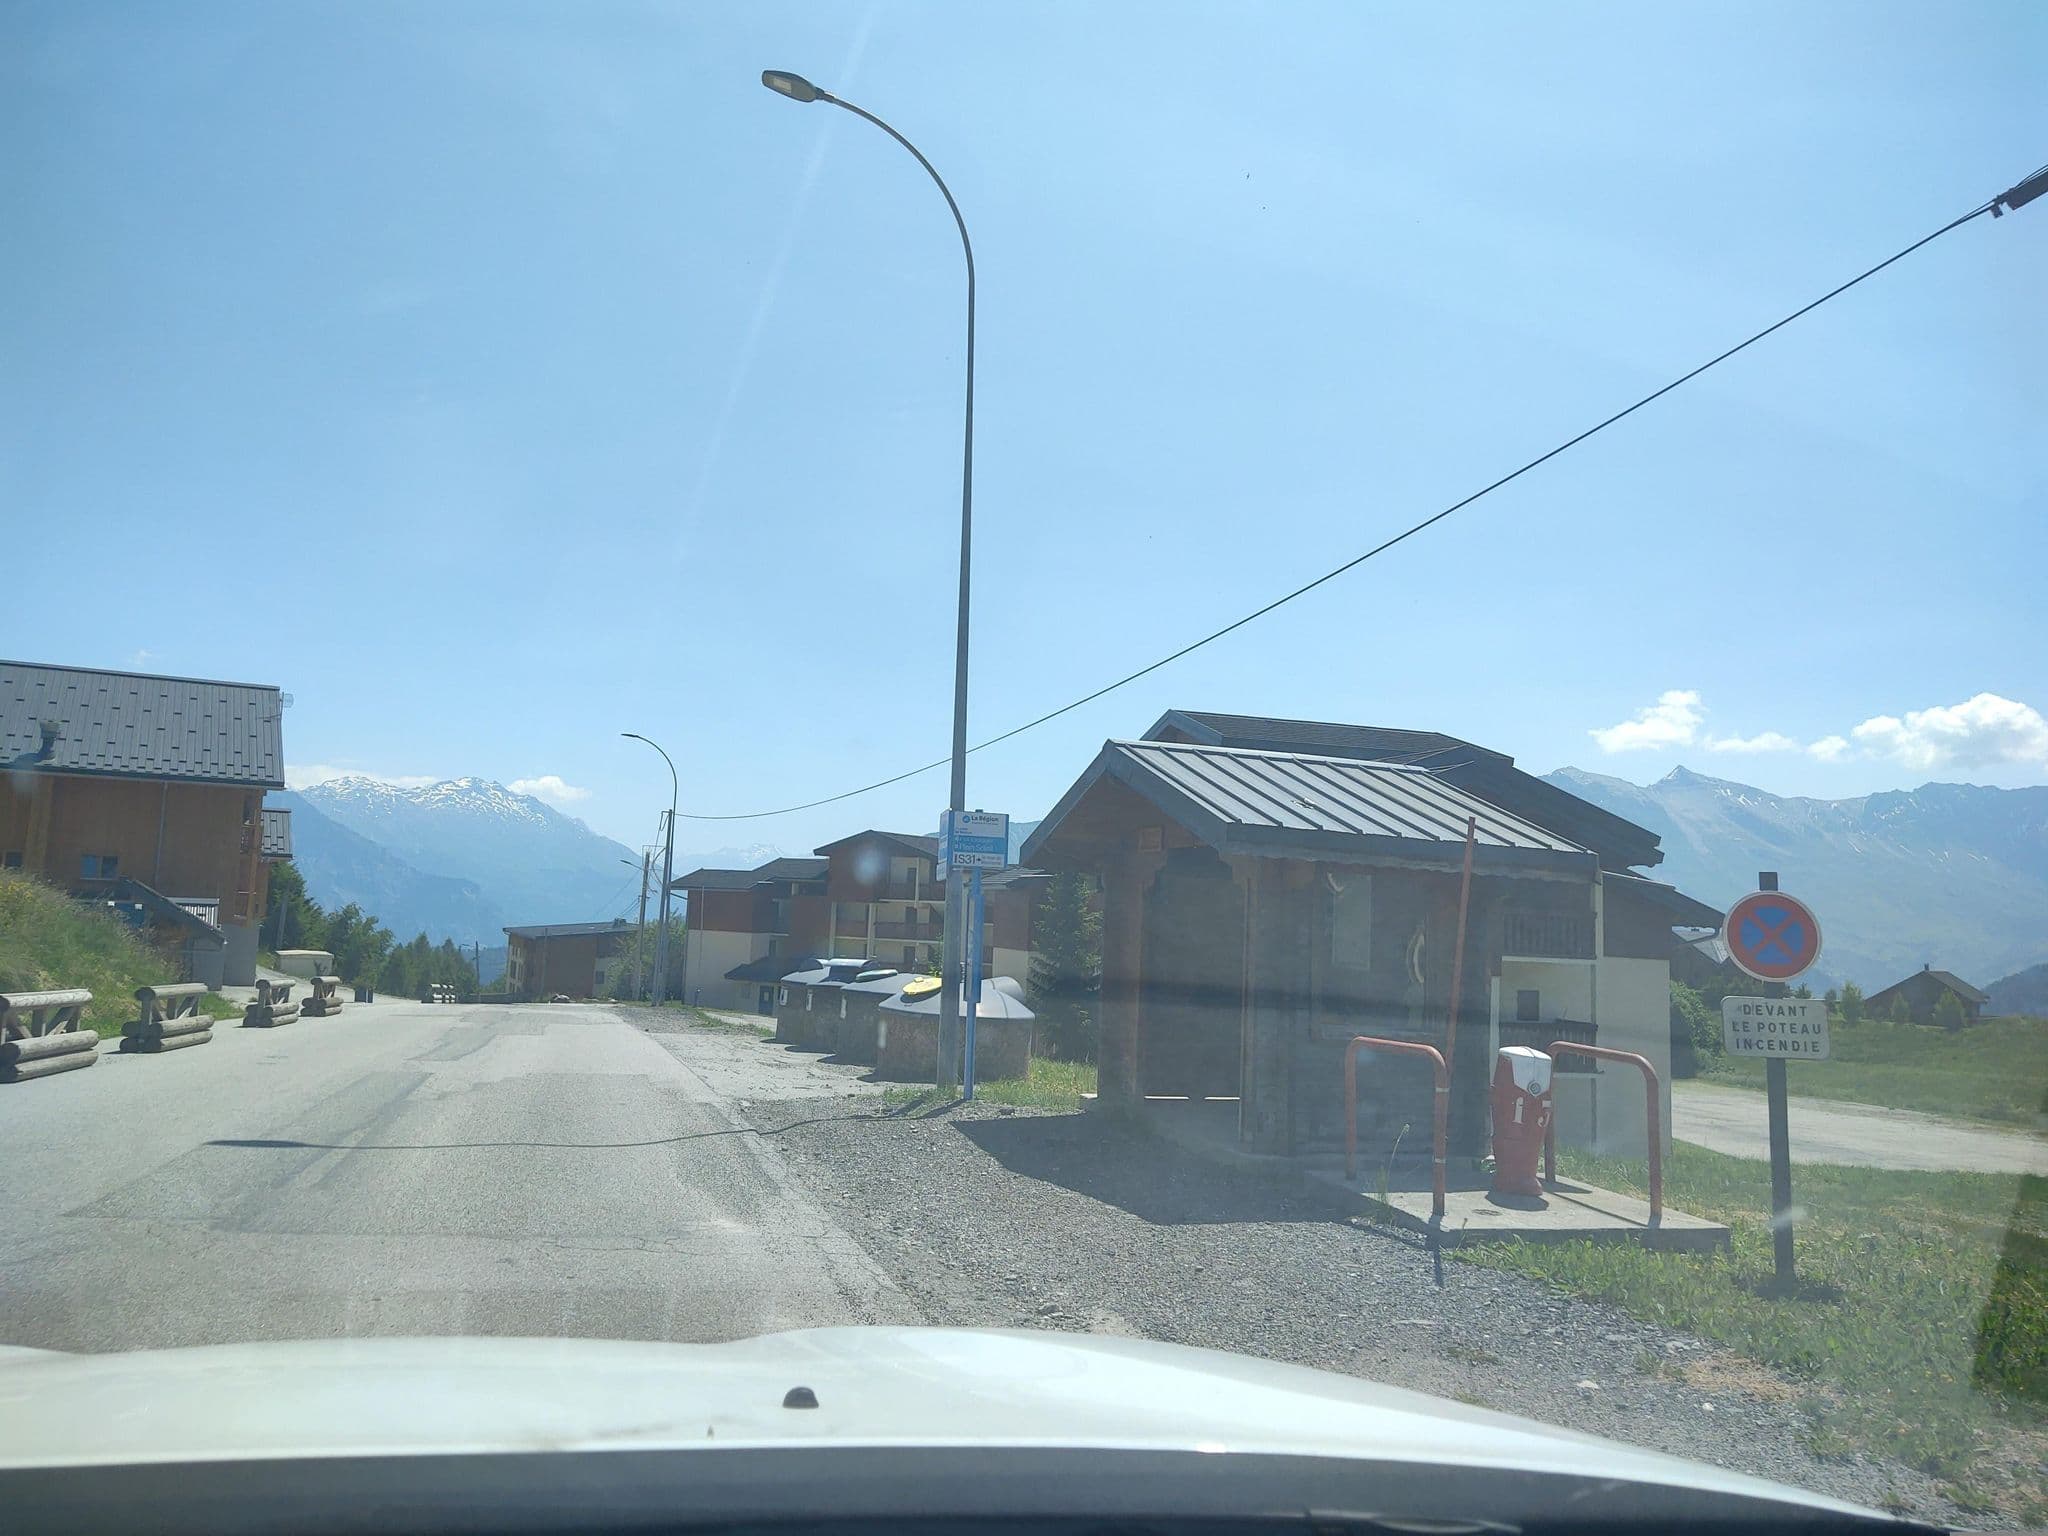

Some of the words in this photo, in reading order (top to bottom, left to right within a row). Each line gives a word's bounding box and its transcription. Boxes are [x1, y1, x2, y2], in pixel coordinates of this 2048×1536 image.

[979, 815, 999, 823] Région
[1742, 1004, 1808, 1017] DEVANT
[1731, 1020, 1751, 1033] LE
[1757, 1022, 1822, 1035] POTEAU
[1735, 1038, 1821, 1053] INCENDIE
